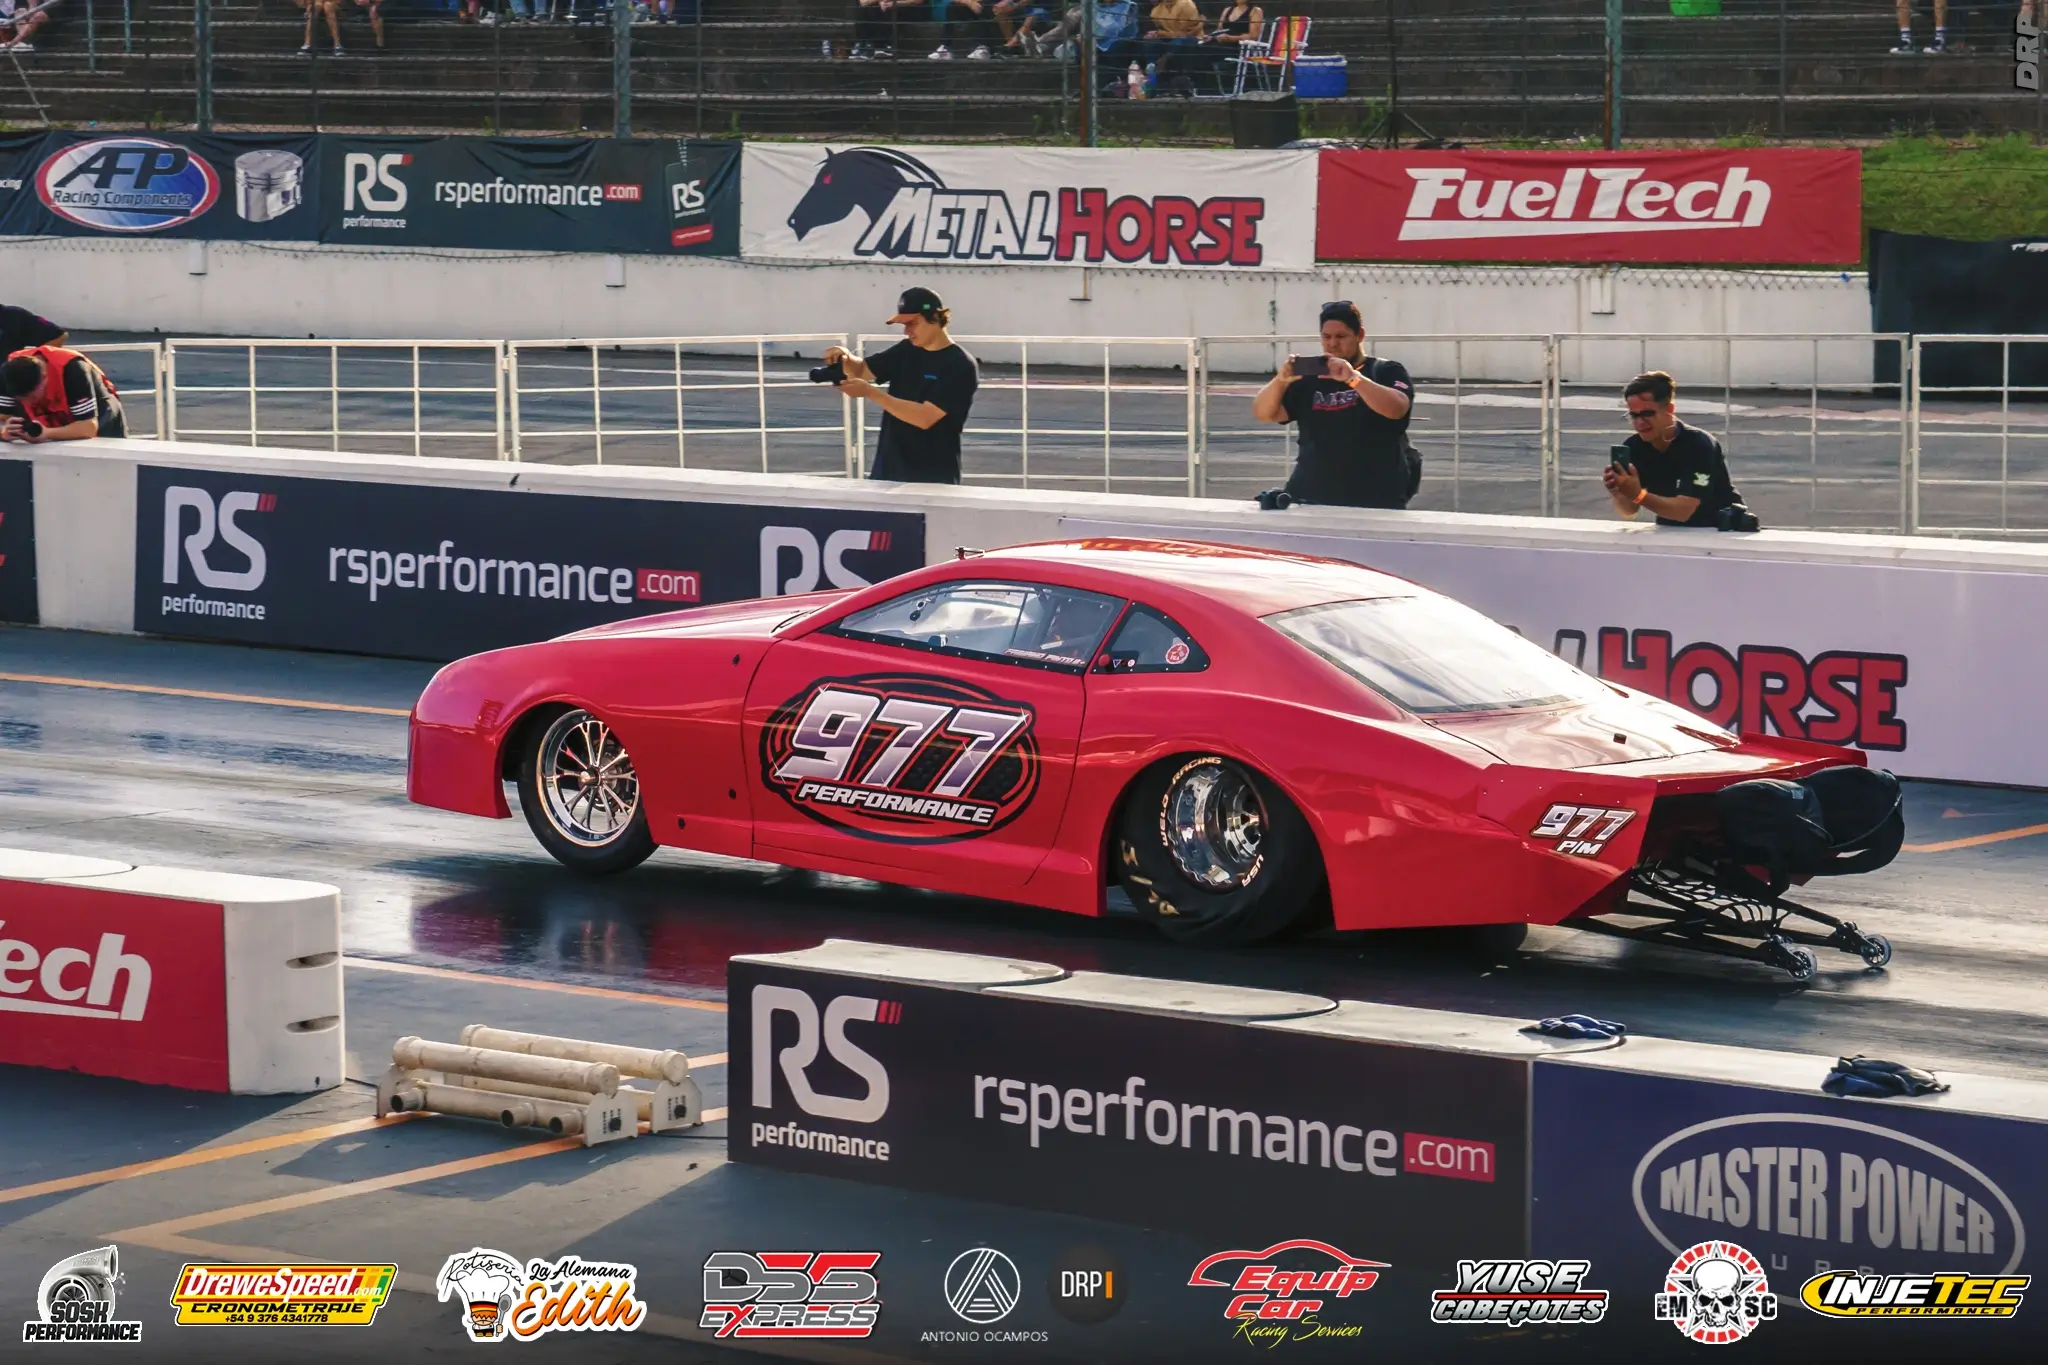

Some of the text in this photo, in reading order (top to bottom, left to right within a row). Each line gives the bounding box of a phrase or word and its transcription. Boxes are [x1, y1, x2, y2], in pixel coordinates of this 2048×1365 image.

[53, 147, 190, 190] AFP
[344, 153, 408, 212] RS
[53, 190, 193, 207] Racing Components
[672, 180, 705, 211] RS
[1405, 167, 1771, 227] FuelTech
[343, 215, 407, 230] performance
[162, 485, 267, 592] RS
[161, 593, 267, 621] performance
[774, 690, 1029, 796] 977
[1172, 756, 1222, 785] RACING
[798, 783, 995, 823] PERFORMANCE
[1533, 804, 1636, 840] 977
[1556, 840, 1602, 855] P/M
[751, 984, 891, 1123] RS
[751, 1121, 890, 1162] performance
[1660, 1147, 1997, 1255] MASTER POWER
